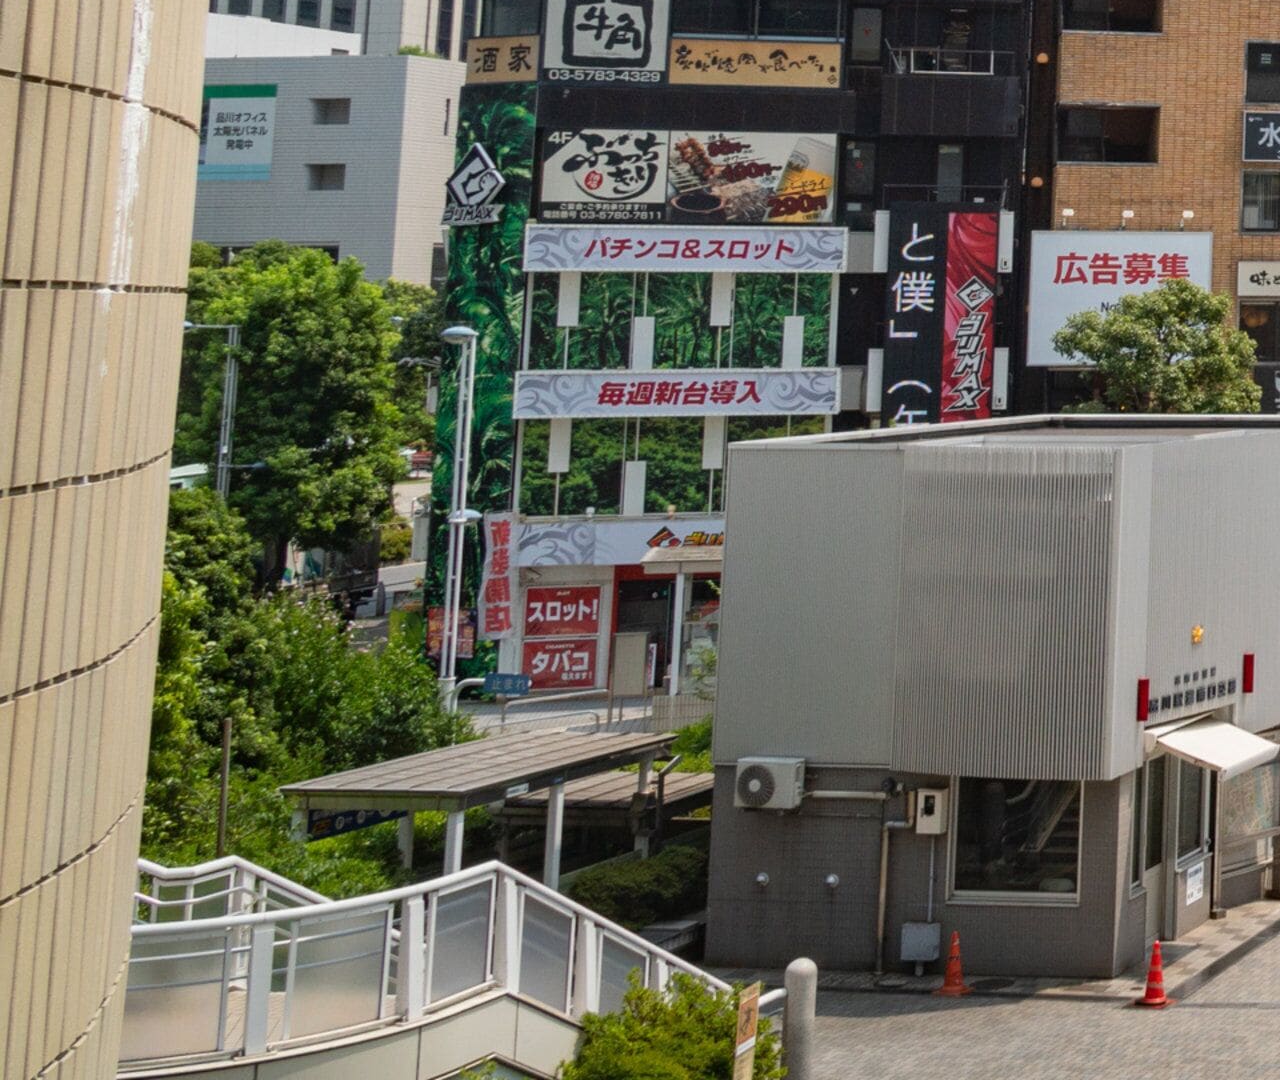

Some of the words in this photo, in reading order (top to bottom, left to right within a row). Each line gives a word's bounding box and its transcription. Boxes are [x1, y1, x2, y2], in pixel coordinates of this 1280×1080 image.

[574, 5, 642, 51] 牛角
[547, 68, 661, 83] 03-5783-4329
[547, 131, 573, 144] 4F
[579, 211, 662, 221] 03-5780-7811
[583, 236, 795, 262] パチンコ&スロット
[1052, 251, 1192, 287] 広告募集
[596, 380, 763, 407] 毎週新台導入
[527, 597, 599, 624] スロット!
[531, 651, 590, 675] タバコ
